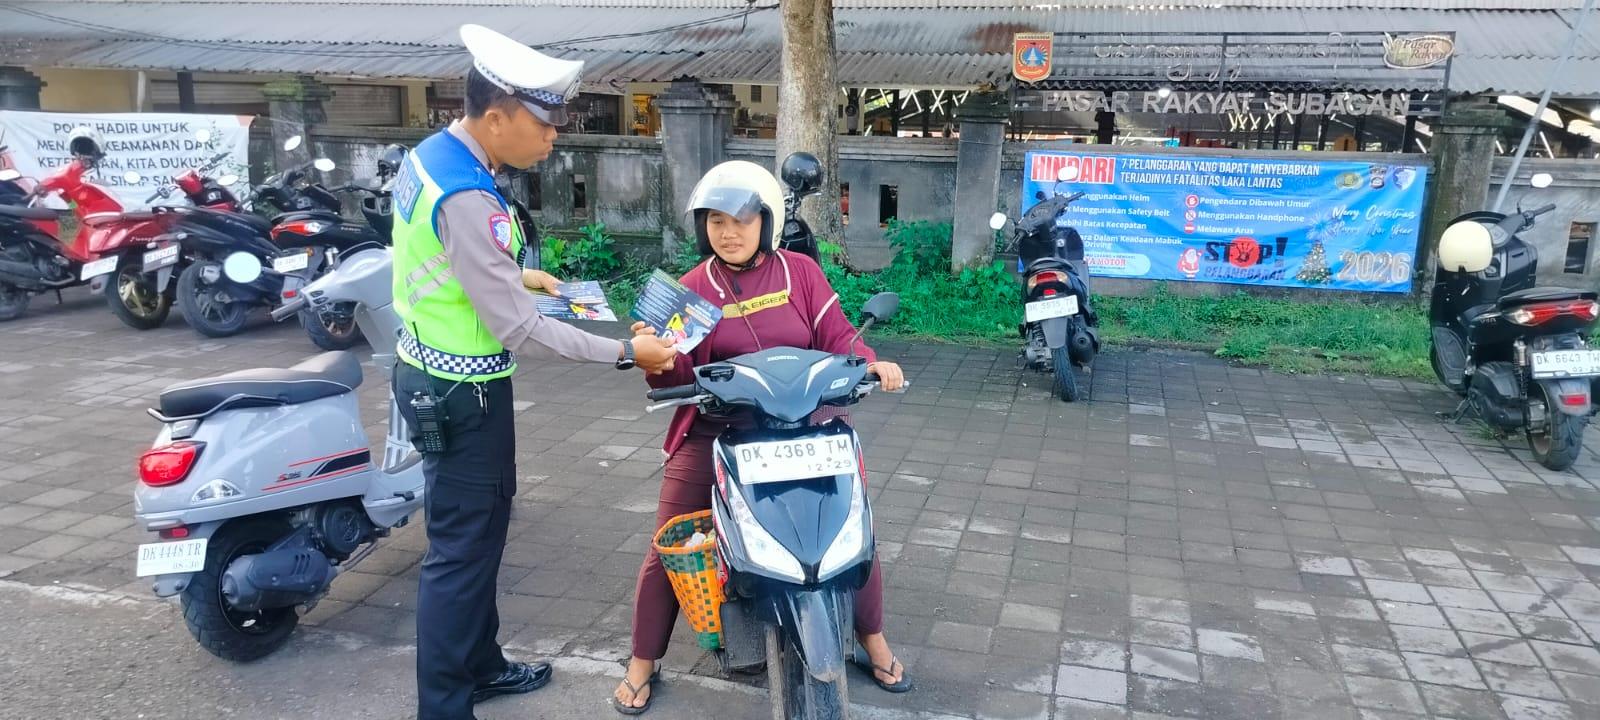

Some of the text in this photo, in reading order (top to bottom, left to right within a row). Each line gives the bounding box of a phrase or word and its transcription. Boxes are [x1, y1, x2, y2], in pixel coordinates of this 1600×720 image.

[1403, 39, 1436, 49] Pasar
[1042, 91, 1411, 116] PASAR RAKYAT SUBAGAN
[96, 123, 138, 134] HADIR
[142, 122, 189, 133] UNTUK
[127, 157, 156, 169] KITA
[1121, 159, 1320, 176] 7 PELANGGARAN YANG DAPAT MENYEBABKAN
[1032, 155, 1115, 184] HINDARI
[1120, 172, 1283, 189] TERJADINYA FATALITAS LAKA LANTAS
[1129, 193, 1150, 202] Helm
[1199, 198, 1310, 208] Pengendara Dibawah Umur
[1072, 205, 1126, 216] Menggunakan
[1127, 207, 1152, 218] Safety
[1154, 208, 1170, 217] Belt
[1198, 212, 1305, 223] Menggunakan Handphone
[1365, 204, 1417, 220] Christmas
[1083, 220, 1104, 228] Batas
[1106, 221, 1147, 230] Kecepatan
[1197, 225, 1254, 235] Melawan Arus
[1094, 234, 1118, 242] Dalam
[1120, 235, 1153, 244] Keadaan
[1154, 236, 1183, 245] Mabuk
[1337, 250, 1411, 282] 2026
[741, 440, 848, 463] DK 4368 TM
[187, 542, 201, 556] TR
